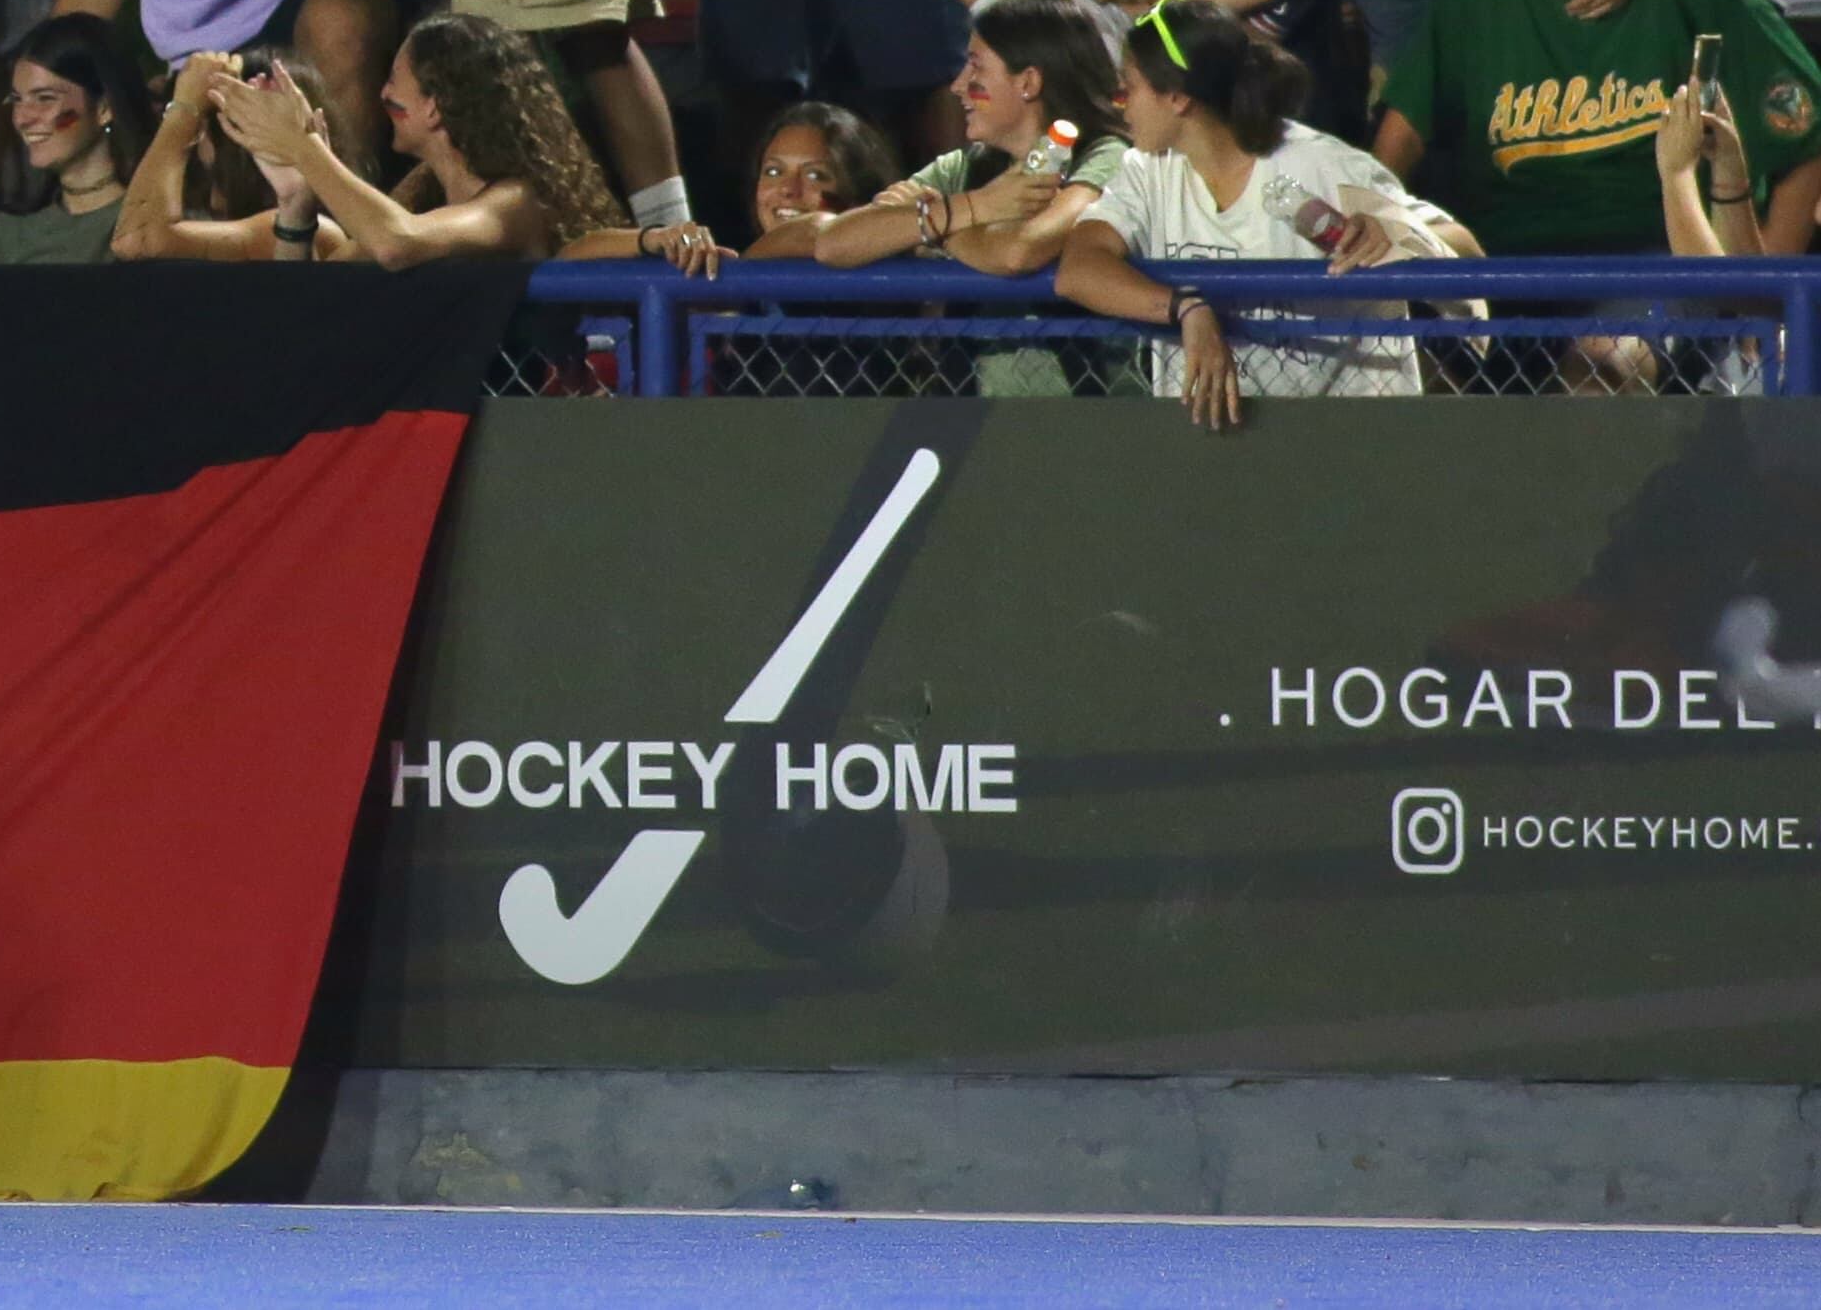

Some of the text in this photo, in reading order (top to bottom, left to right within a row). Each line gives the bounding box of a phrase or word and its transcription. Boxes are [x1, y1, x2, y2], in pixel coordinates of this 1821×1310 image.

[1488, 70, 1668, 145] Athletics
[1271, 666, 1573, 729] HOGAR
[1613, 669, 1777, 730] DEL
[390, 740, 1018, 813] HOCKEY HOME
